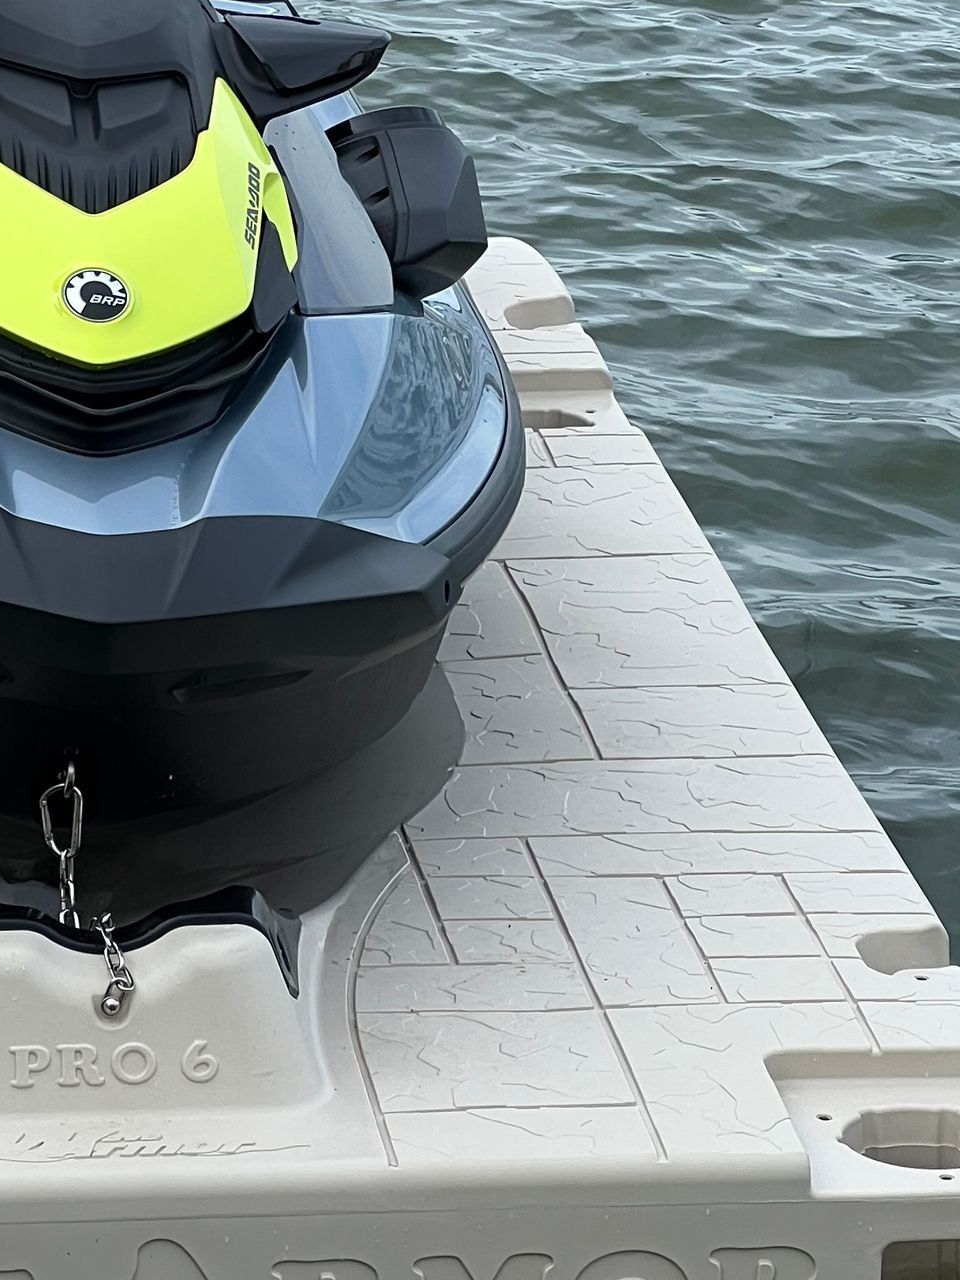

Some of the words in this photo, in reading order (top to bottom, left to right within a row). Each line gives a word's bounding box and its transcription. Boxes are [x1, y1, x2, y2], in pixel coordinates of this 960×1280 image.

[89, 294, 126, 307] BRP
[8, 1041, 158, 1089] PRO
[181, 1039, 219, 1084] 6
